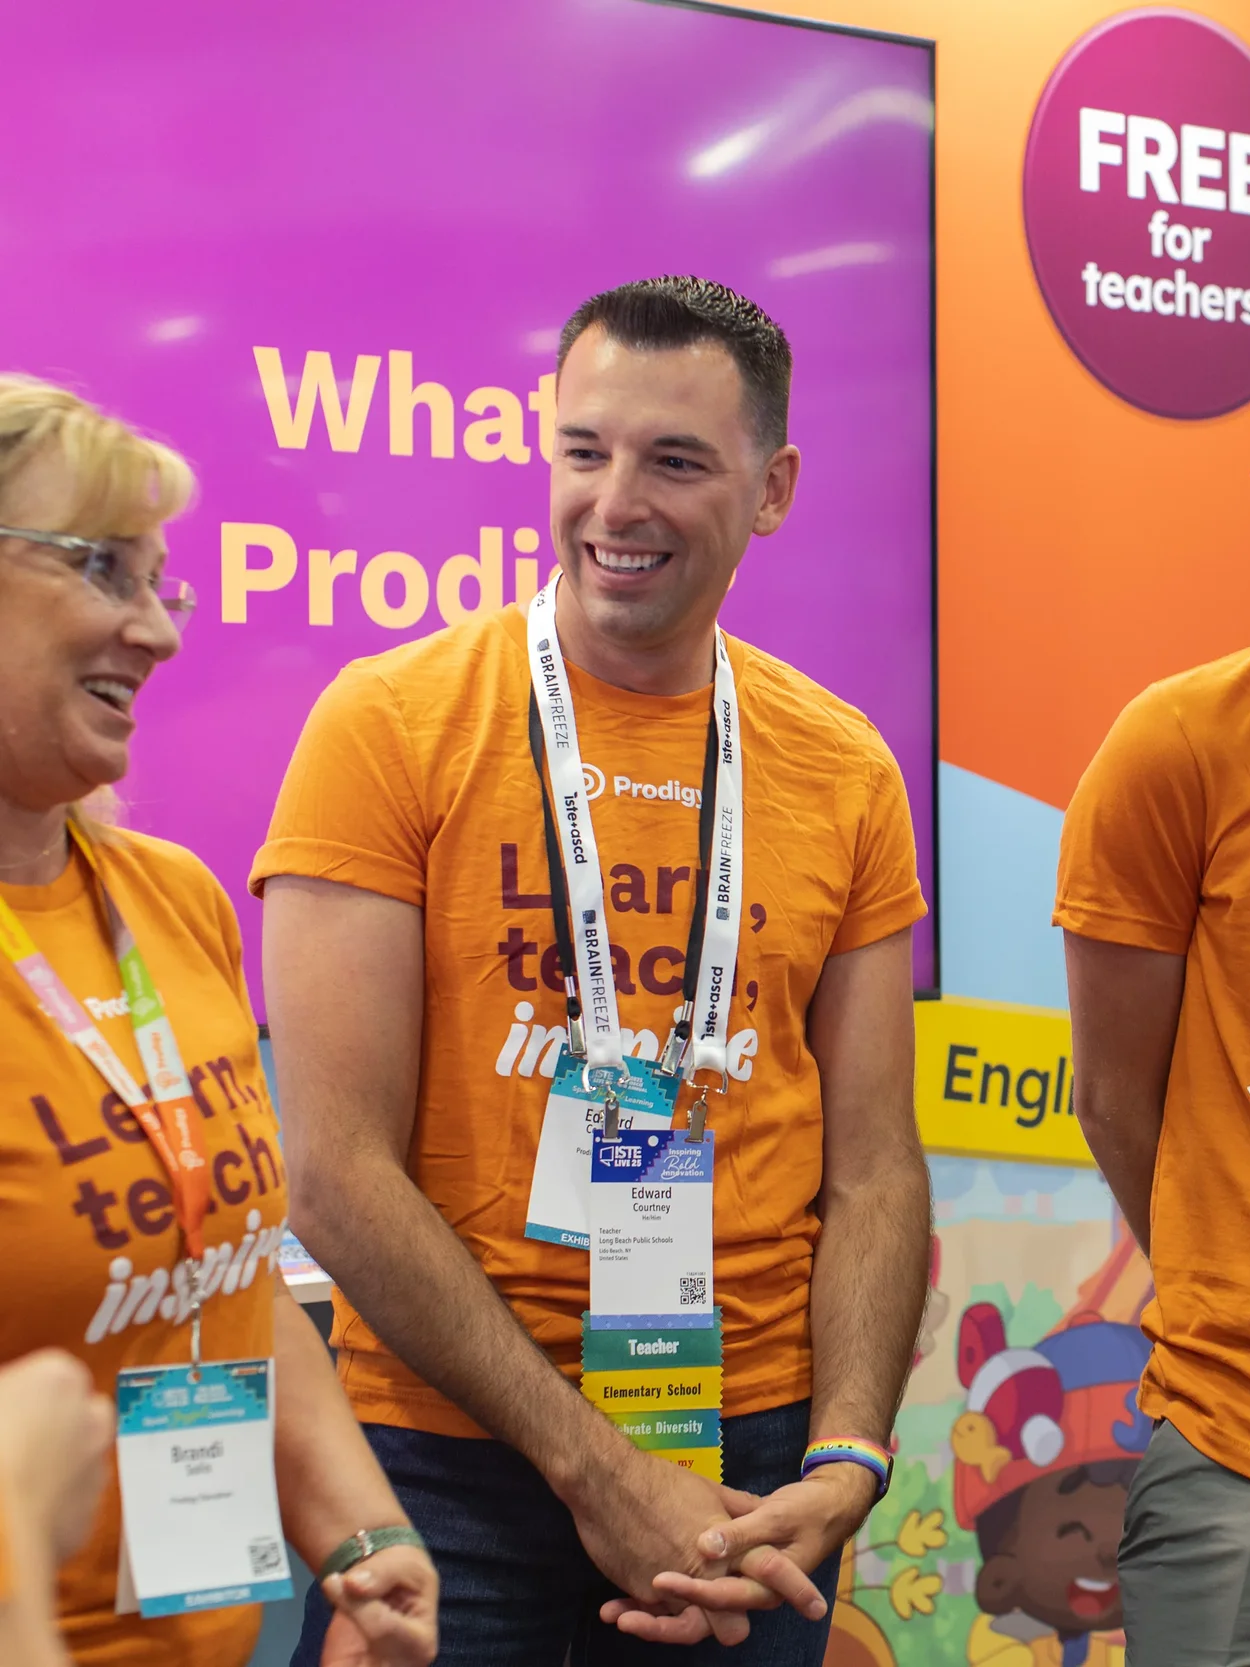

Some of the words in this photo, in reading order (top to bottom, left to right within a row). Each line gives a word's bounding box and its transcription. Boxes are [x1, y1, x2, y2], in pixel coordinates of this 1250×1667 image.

[1148, 210, 1212, 263] for
[221, 521, 562, 629] Prodi
[540, 654, 569, 749] BRAINFREEZE
[564, 791, 587, 864] iste+ascd
[718, 806, 733, 903] BRAINFREEZE
[500, 843, 767, 934] Lar,
[585, 929, 611, 1034] BRAINFREEZE
[700, 966, 724, 1041] iste+ascd
[615, 1146, 642, 1159] ISTE
[669, 1148, 701, 1157] Inspiring
[631, 1159, 642, 1167] 25
[662, 1155, 700, 1174] Bold
[662, 1169, 704, 1177] Innovation
[632, 1187, 672, 1199] Edward
[633, 1203, 671, 1214] Courtney
[599, 1237, 613, 1245] Long
[633, 1236, 651, 1244] Public
[652, 1236, 674, 1244] Schools
[628, 1338, 680, 1356] Teacher
[603, 1385, 662, 1399] Elementary
[667, 1383, 701, 1396] School
[655, 1420, 703, 1435] Diversity
[678, 1459, 695, 1469] my
